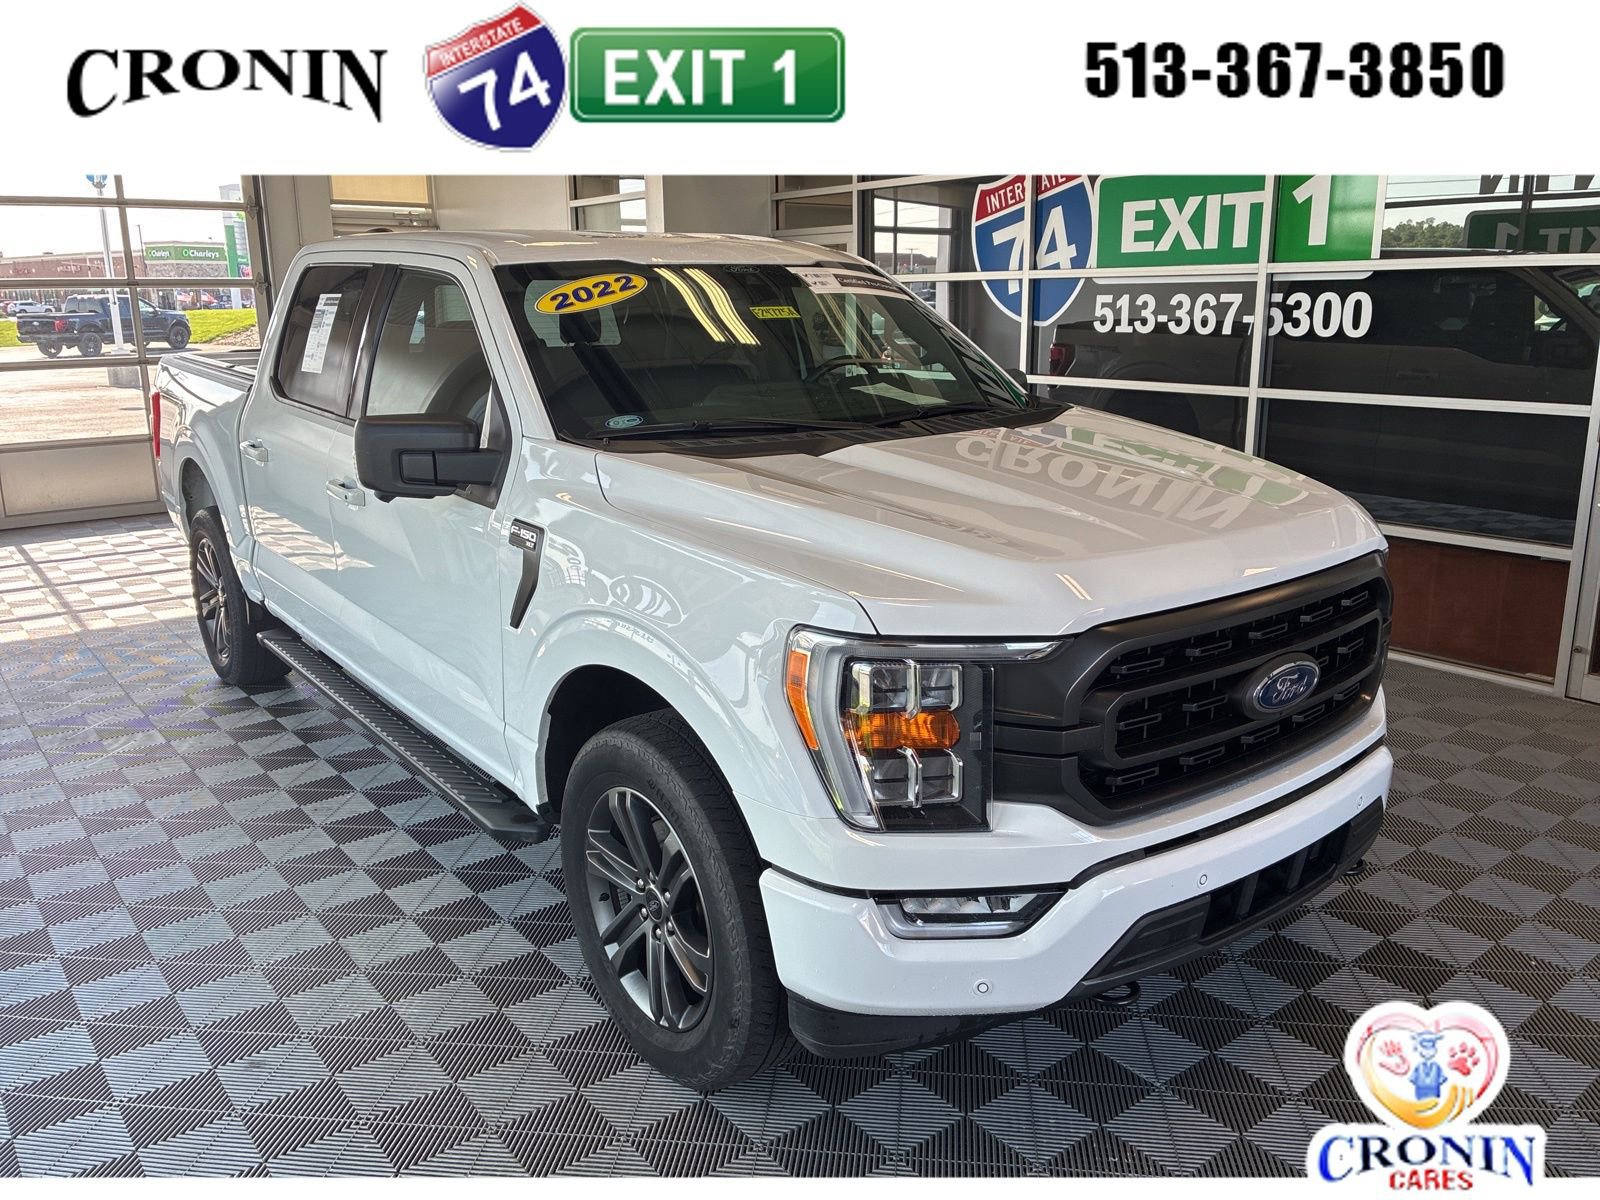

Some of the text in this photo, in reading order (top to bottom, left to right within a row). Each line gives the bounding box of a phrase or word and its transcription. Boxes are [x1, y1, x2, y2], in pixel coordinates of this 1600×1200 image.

[1120, 175, 1331, 253] EXIT 1
[992, 205, 1077, 295] 74
[549, 275, 639, 312] 2022
[1093, 291, 1373, 338] 513-367-5300
[511, 525, 537, 543] F-150
[1272, 671, 1308, 704] Ford
